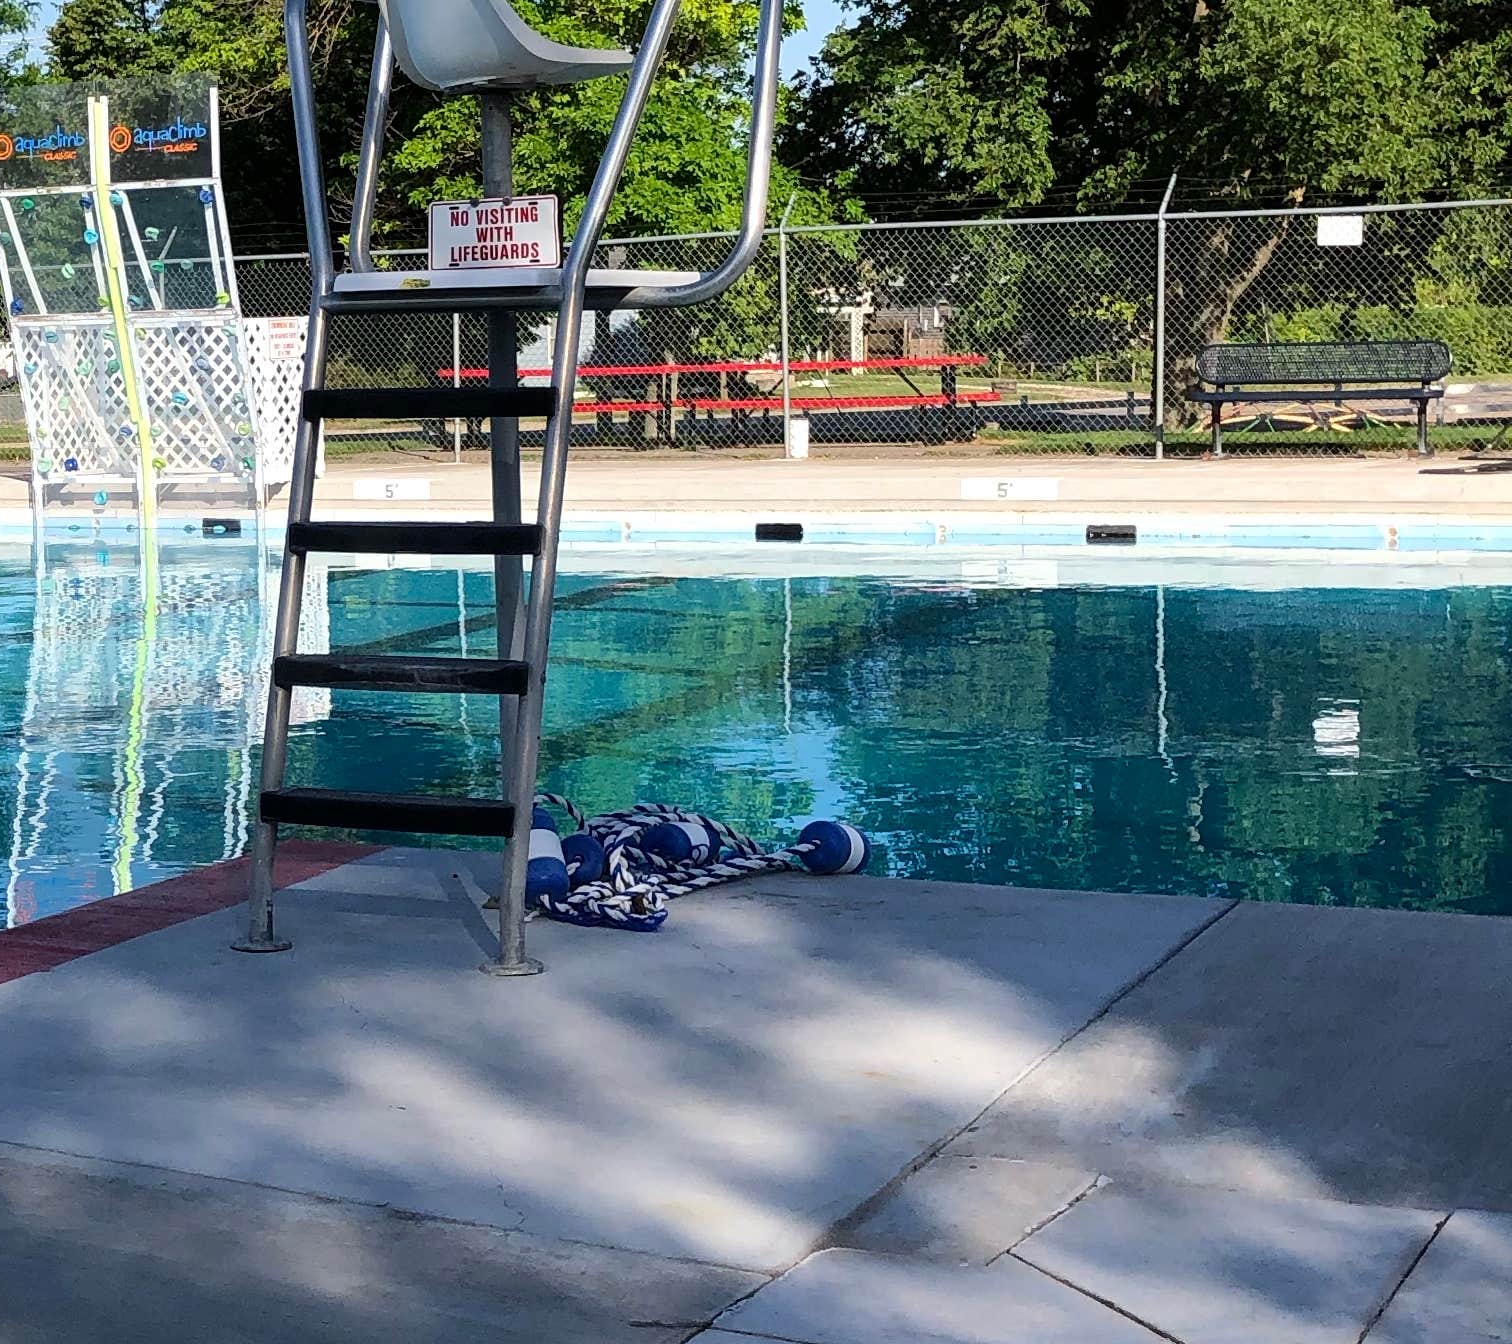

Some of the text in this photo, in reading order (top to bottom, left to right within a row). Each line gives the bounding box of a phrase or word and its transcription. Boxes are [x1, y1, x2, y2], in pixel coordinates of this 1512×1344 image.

[450, 206, 538, 227] NO VISITING
[476, 226, 513, 243] WITH
[450, 242, 540, 263] LIFEGUARDS
